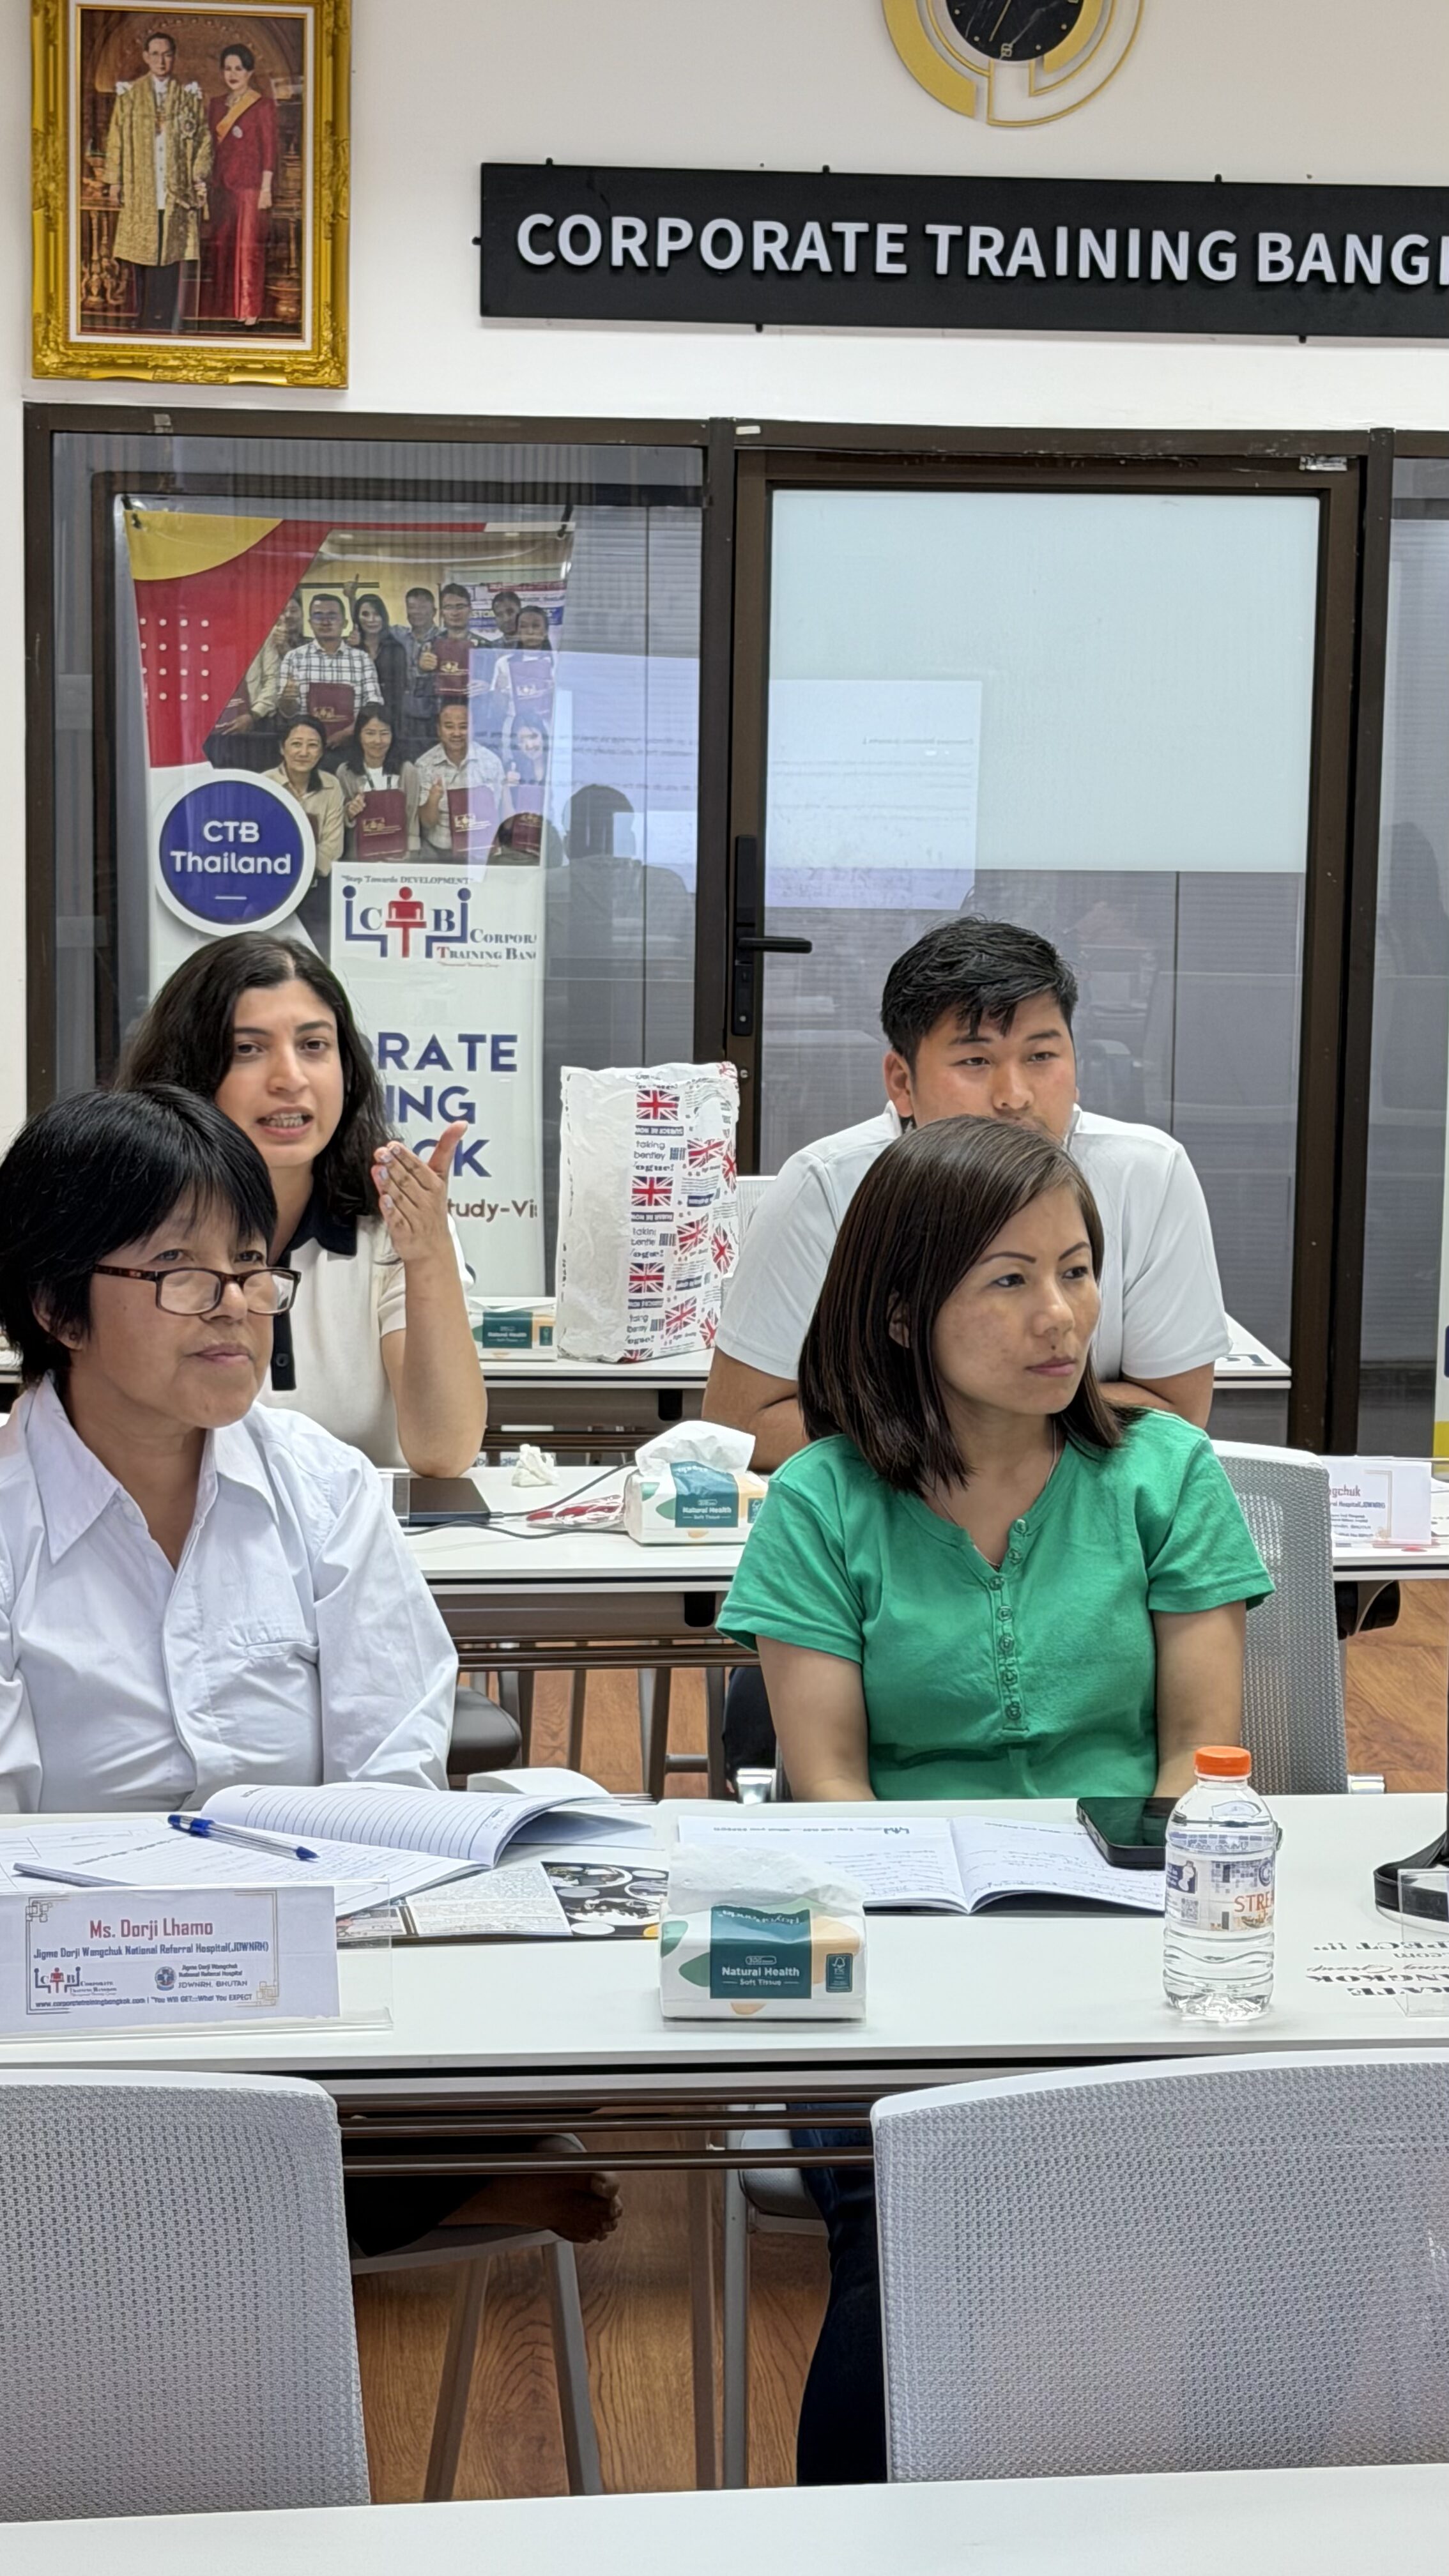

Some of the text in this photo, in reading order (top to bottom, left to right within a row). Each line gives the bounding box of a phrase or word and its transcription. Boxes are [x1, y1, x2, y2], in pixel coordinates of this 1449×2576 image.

[518, 214, 907, 273] CORPORATE
[926, 225, 1236, 280] TRAINING
[203, 820, 260, 843] CTB
[170, 850, 291, 875] Thailand
[364, 1032, 518, 1072] RATE
[636, 1140, 666, 1151] taking
[89, 1917, 213, 1941] Ms. Dorji Lhamo
[33, 1948, 59, 1960] Jigme
[60, 1947, 80, 1959] Dorji
[82, 1945, 123, 1958] Wangchuk
[125, 1943, 158, 1956] National
[160, 1943, 194, 1955] Referral
[721, 1966, 801, 1977] Natural Health
[758, 1979, 782, 1987] Tissue
[228, 1993, 252, 2001] EXPECT
